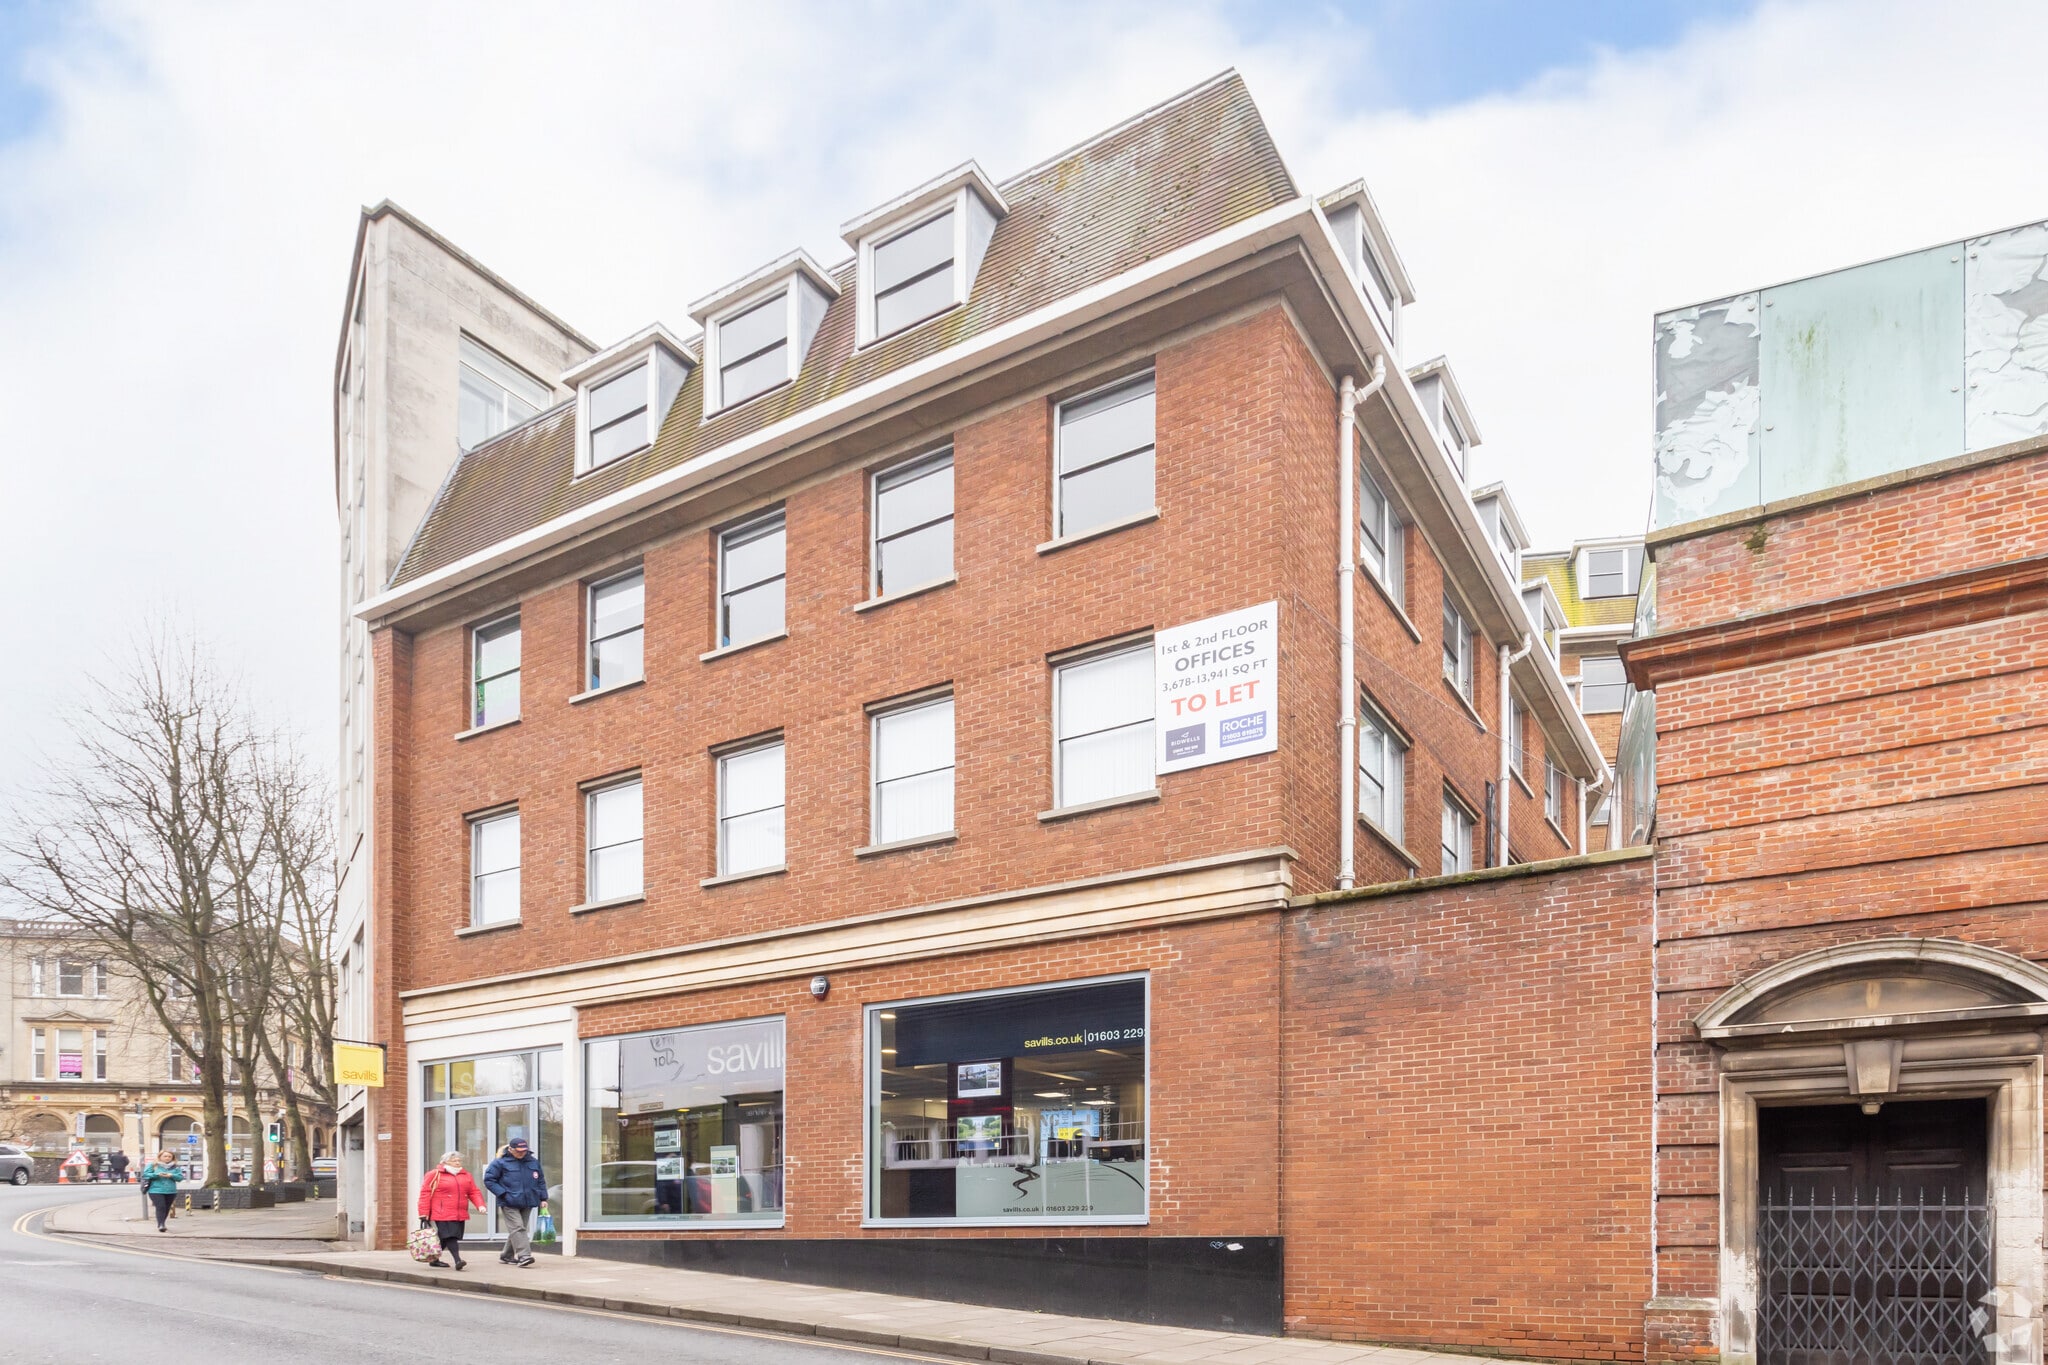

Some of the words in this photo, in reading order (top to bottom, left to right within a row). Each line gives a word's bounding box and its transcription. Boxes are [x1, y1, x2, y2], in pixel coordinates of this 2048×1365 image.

[1162, 644, 1177, 655] 1st
[1181, 640, 1191, 650] &
[1195, 633, 1217, 647] 2nd
[1221, 619, 1268, 640] FLOOR
[1175, 640, 1255, 672] OFFICES
[1162, 668, 1228, 692] 3,678-13,941
[1232, 663, 1250, 675] SQ
[1253, 658, 1268, 670] FT
[1171, 693, 1207, 716] TO
[1215, 680, 1260, 707] LET
[1222, 714, 1264, 733] ROCHE
[1024, 1033, 1083, 1048] savills.co.uk
[1087, 1029, 1120, 1042] 01603
[1123, 1027, 1145, 1039] 229
[342, 1070, 378, 1082] savills
[1002, 1205, 1040, 1213] savills.co.uk
